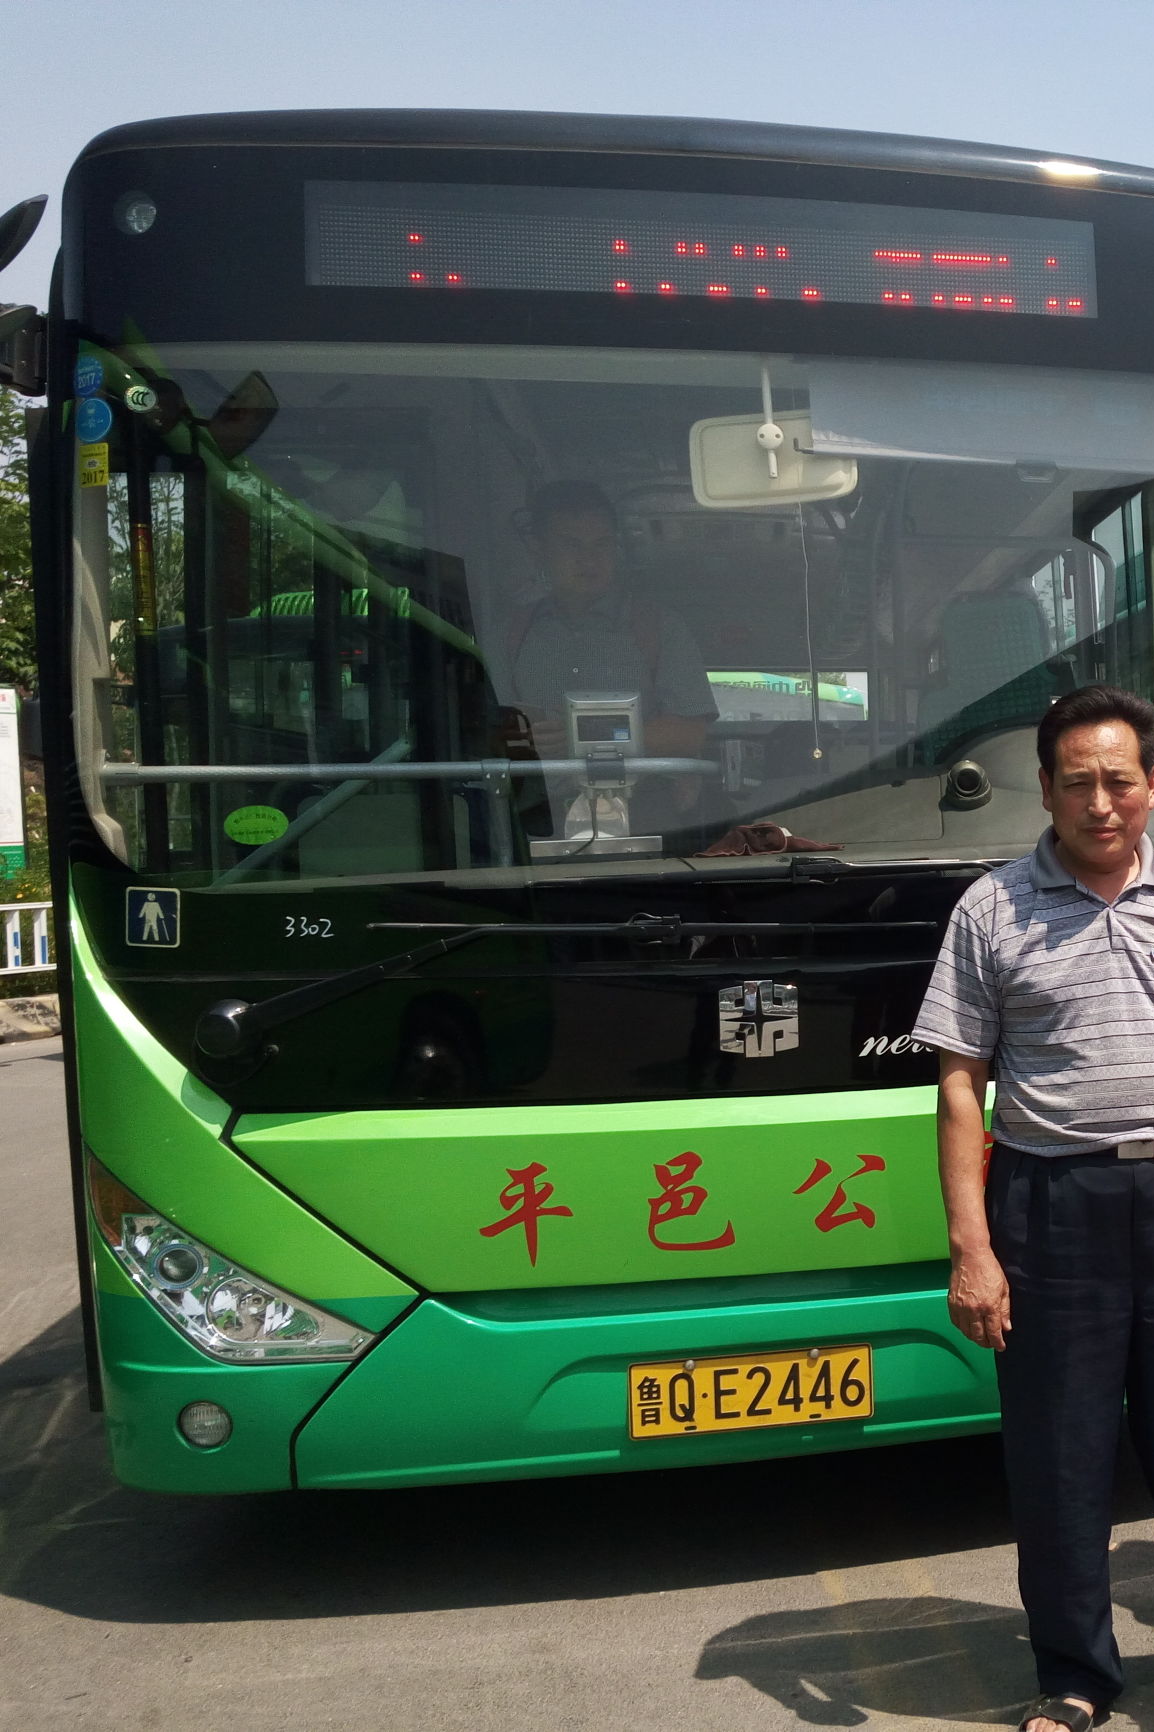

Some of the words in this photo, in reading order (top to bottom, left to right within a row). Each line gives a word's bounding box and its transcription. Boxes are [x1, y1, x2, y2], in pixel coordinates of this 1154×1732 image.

[81, 469, 105, 485] 2017
[285, 915, 335, 938] 3302
[478, 1131, 993, 1268] 平邑公
